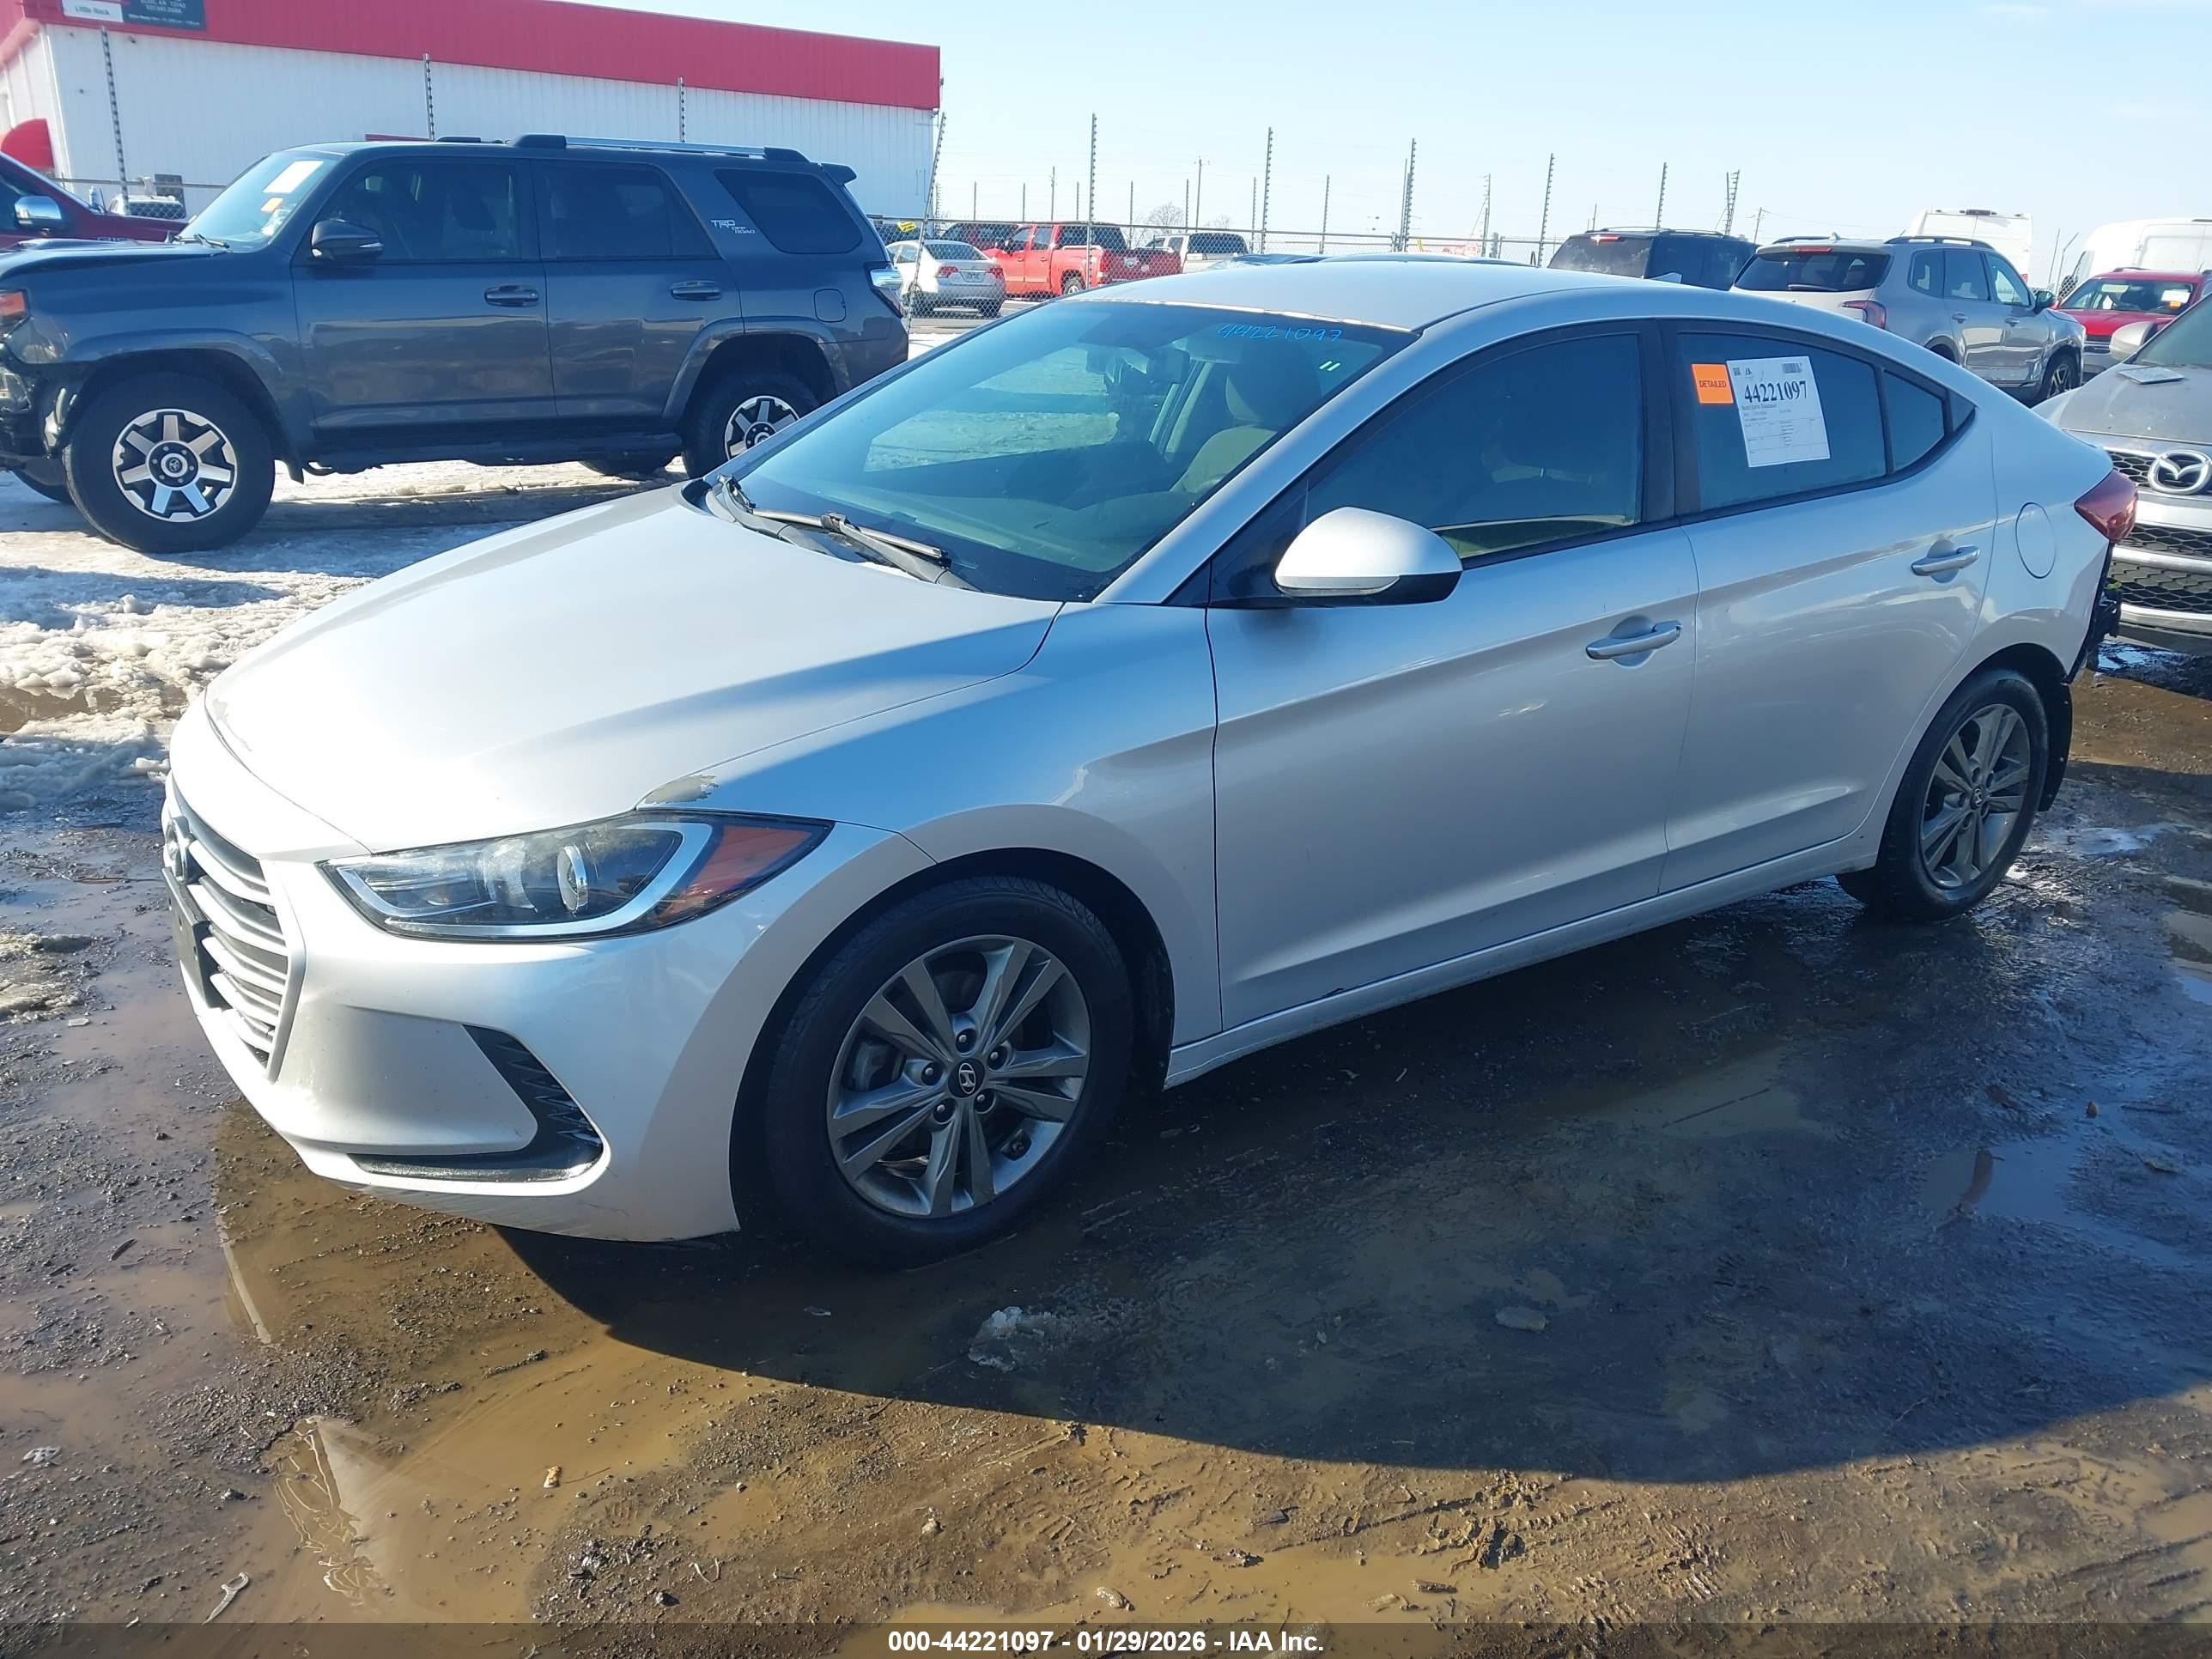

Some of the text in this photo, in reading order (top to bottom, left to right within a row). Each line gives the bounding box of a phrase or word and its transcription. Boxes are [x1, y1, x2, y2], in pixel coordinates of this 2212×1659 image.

[75, 5, 110, 15] Little Rock
[710, 219, 736, 229] TRD
[1217, 323, 1342, 342] 44221097
[1698, 380, 1727, 388] DETAILED
[1744, 380, 1807, 404] 44221097
